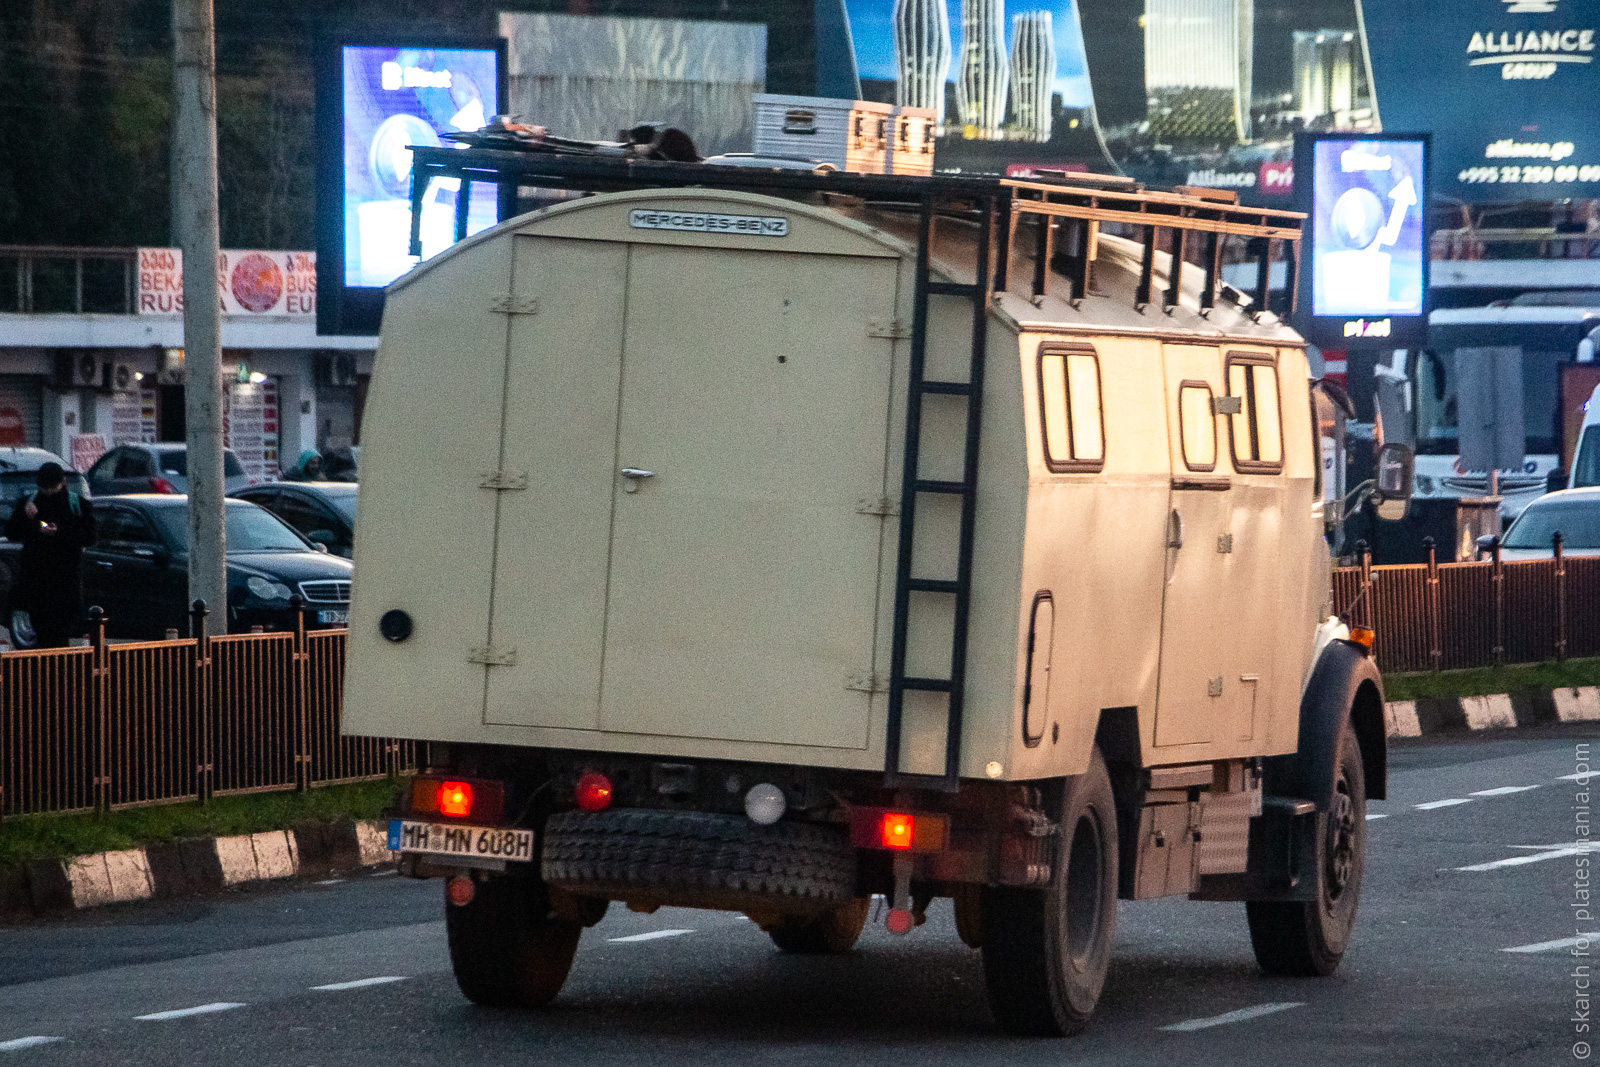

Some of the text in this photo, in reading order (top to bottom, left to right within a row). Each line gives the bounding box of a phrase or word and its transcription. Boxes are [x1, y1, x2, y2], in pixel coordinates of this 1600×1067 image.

[1467, 29, 1595, 54] ALLIANCE
[1186, 169, 1256, 187] Alliance
[633, 213, 784, 232] MERCEDES-BENZ
[286, 275, 317, 293] BUS
[402, 824, 529, 857] MH MN 608H
